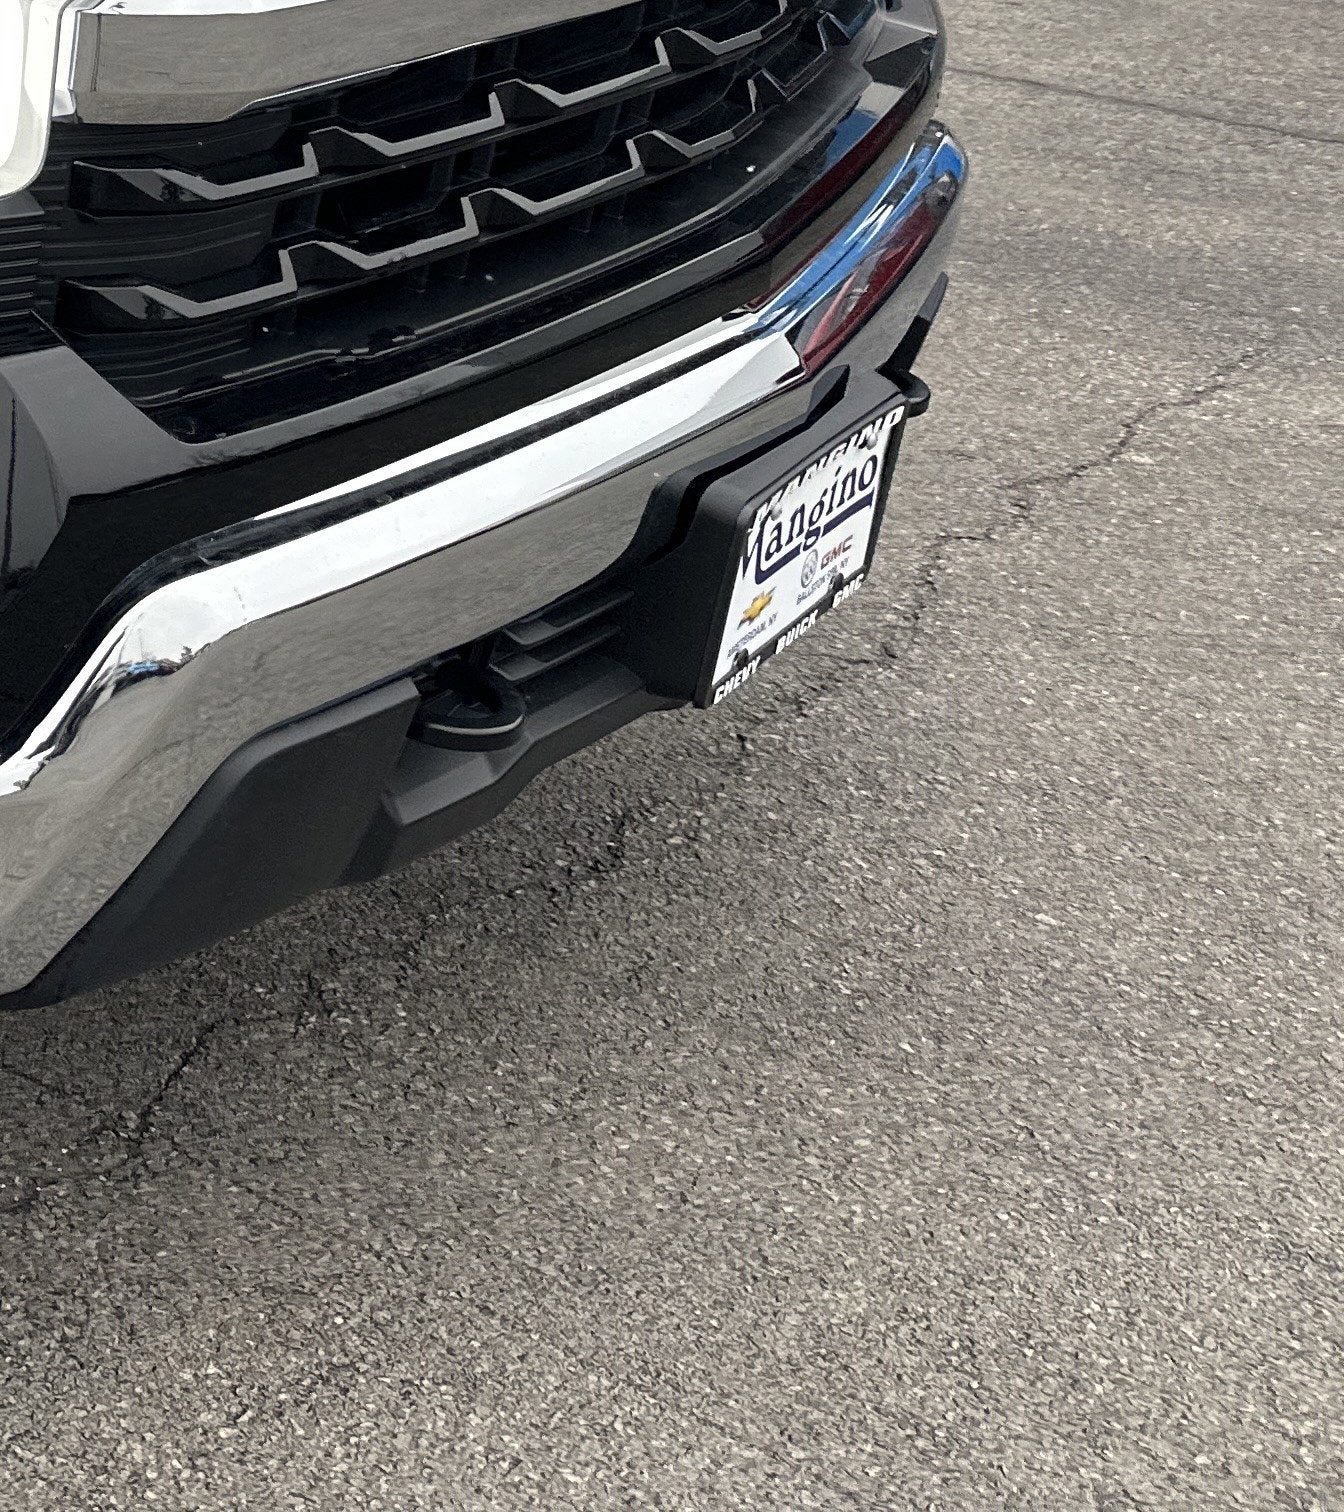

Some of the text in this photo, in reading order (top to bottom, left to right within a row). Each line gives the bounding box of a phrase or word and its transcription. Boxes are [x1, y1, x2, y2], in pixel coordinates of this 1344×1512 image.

[821, 534, 853, 570] GMC
[713, 573, 865, 705] CHEVY BUICK GMC
